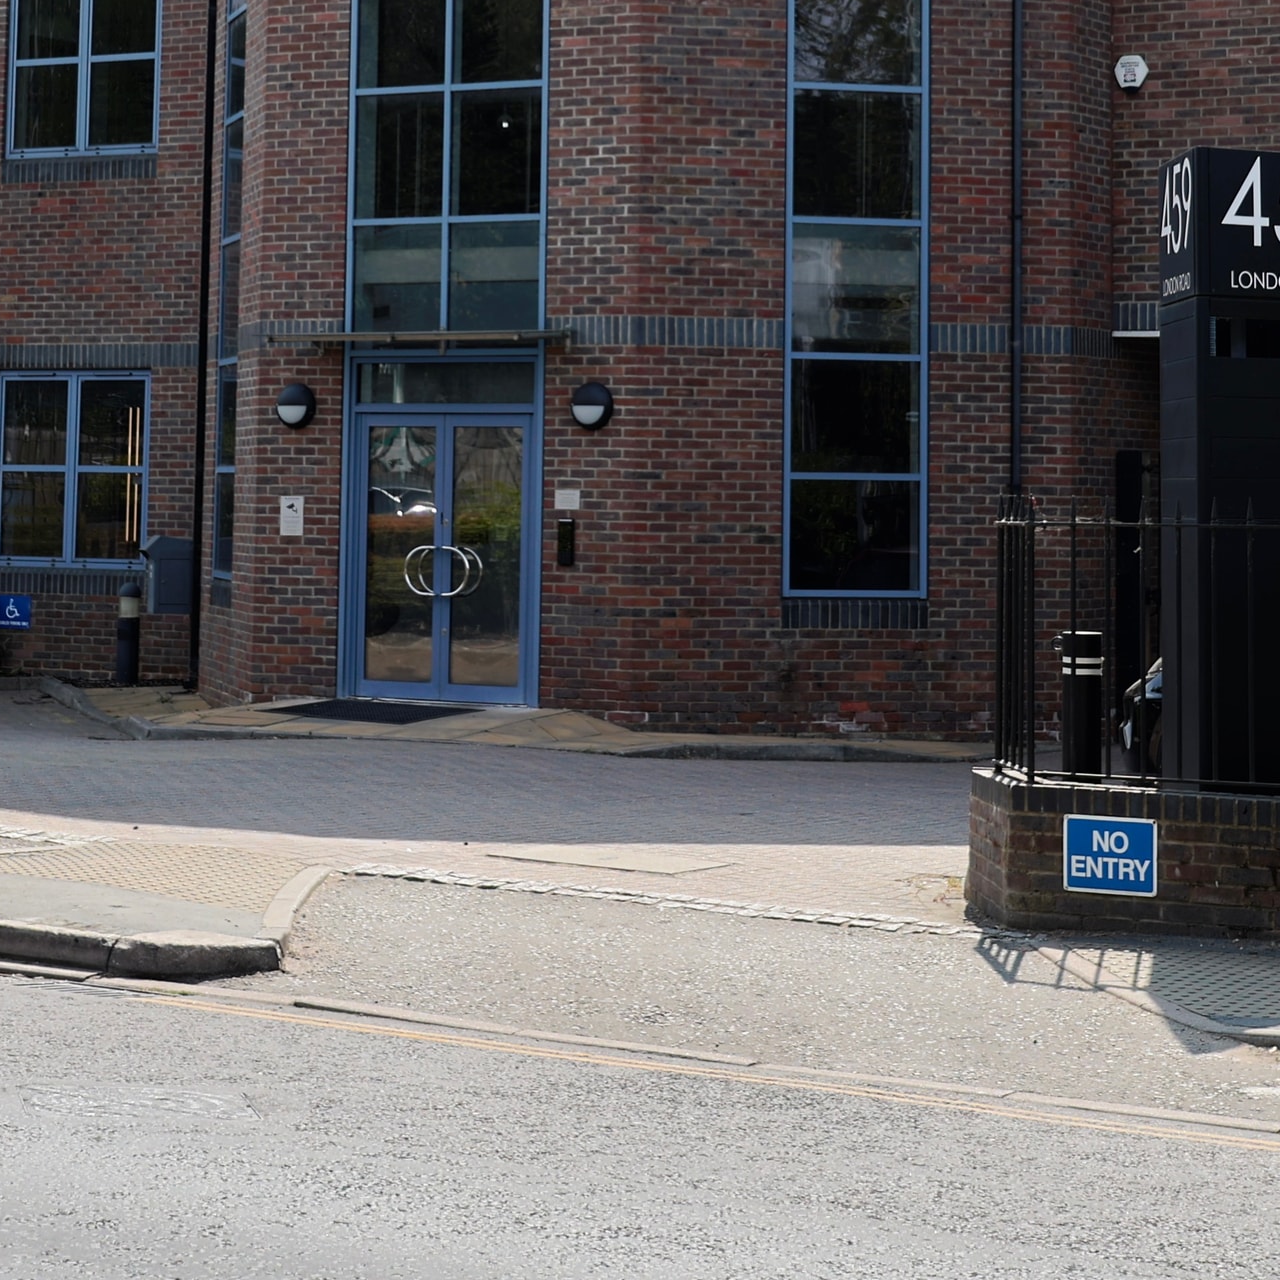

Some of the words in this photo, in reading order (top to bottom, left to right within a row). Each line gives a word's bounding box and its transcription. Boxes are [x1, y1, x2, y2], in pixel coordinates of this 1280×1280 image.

[1161, 157, 1192, 254] 459
[1163, 276, 1179, 297] LONDON
[1179, 272, 1191, 291] ROAD
[1092, 830, 1129, 854] NO
[1071, 855, 1151, 882] ENTRY
